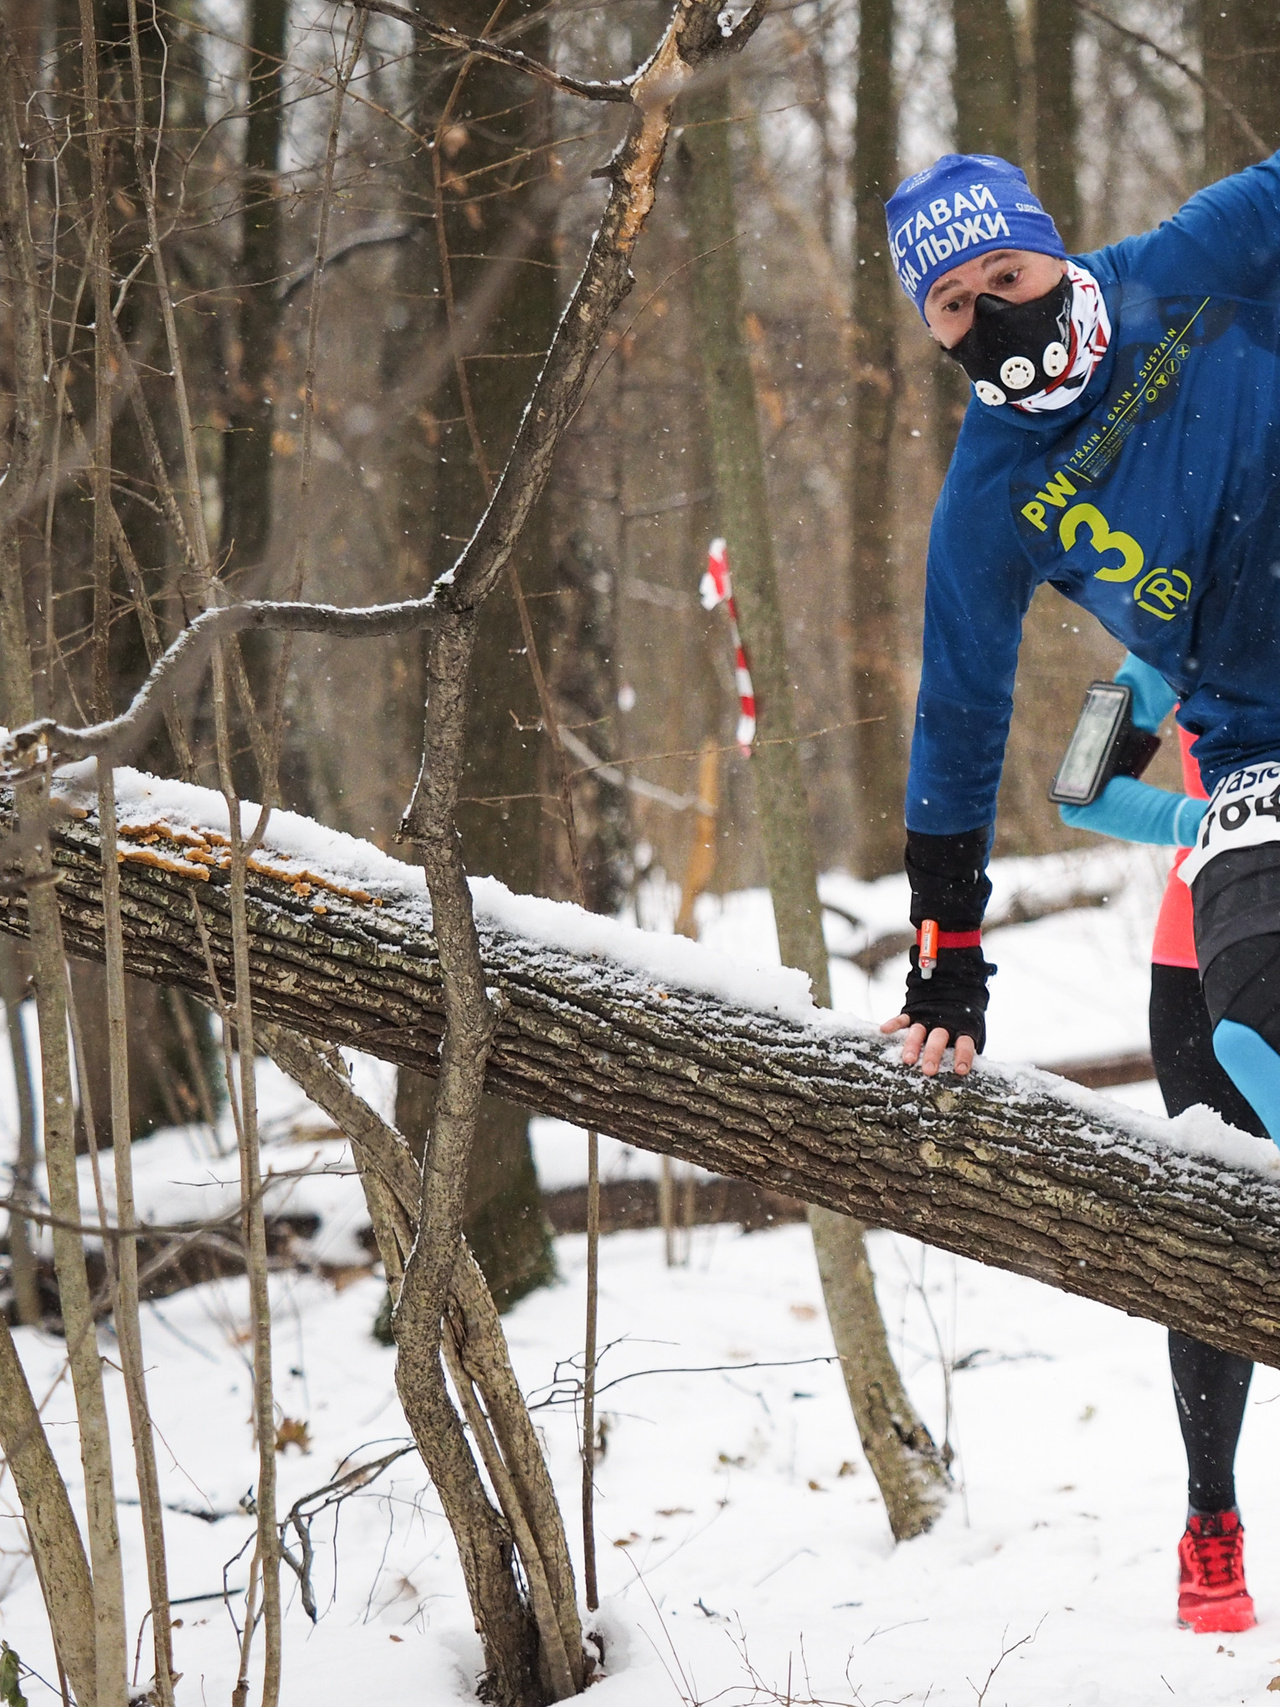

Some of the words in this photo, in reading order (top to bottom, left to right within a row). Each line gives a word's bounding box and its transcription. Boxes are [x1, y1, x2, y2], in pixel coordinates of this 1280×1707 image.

[915, 211, 1011, 275] ЛЫЖИ
[1021, 471, 1077, 532] PW
[1059, 503, 1145, 583] 3
